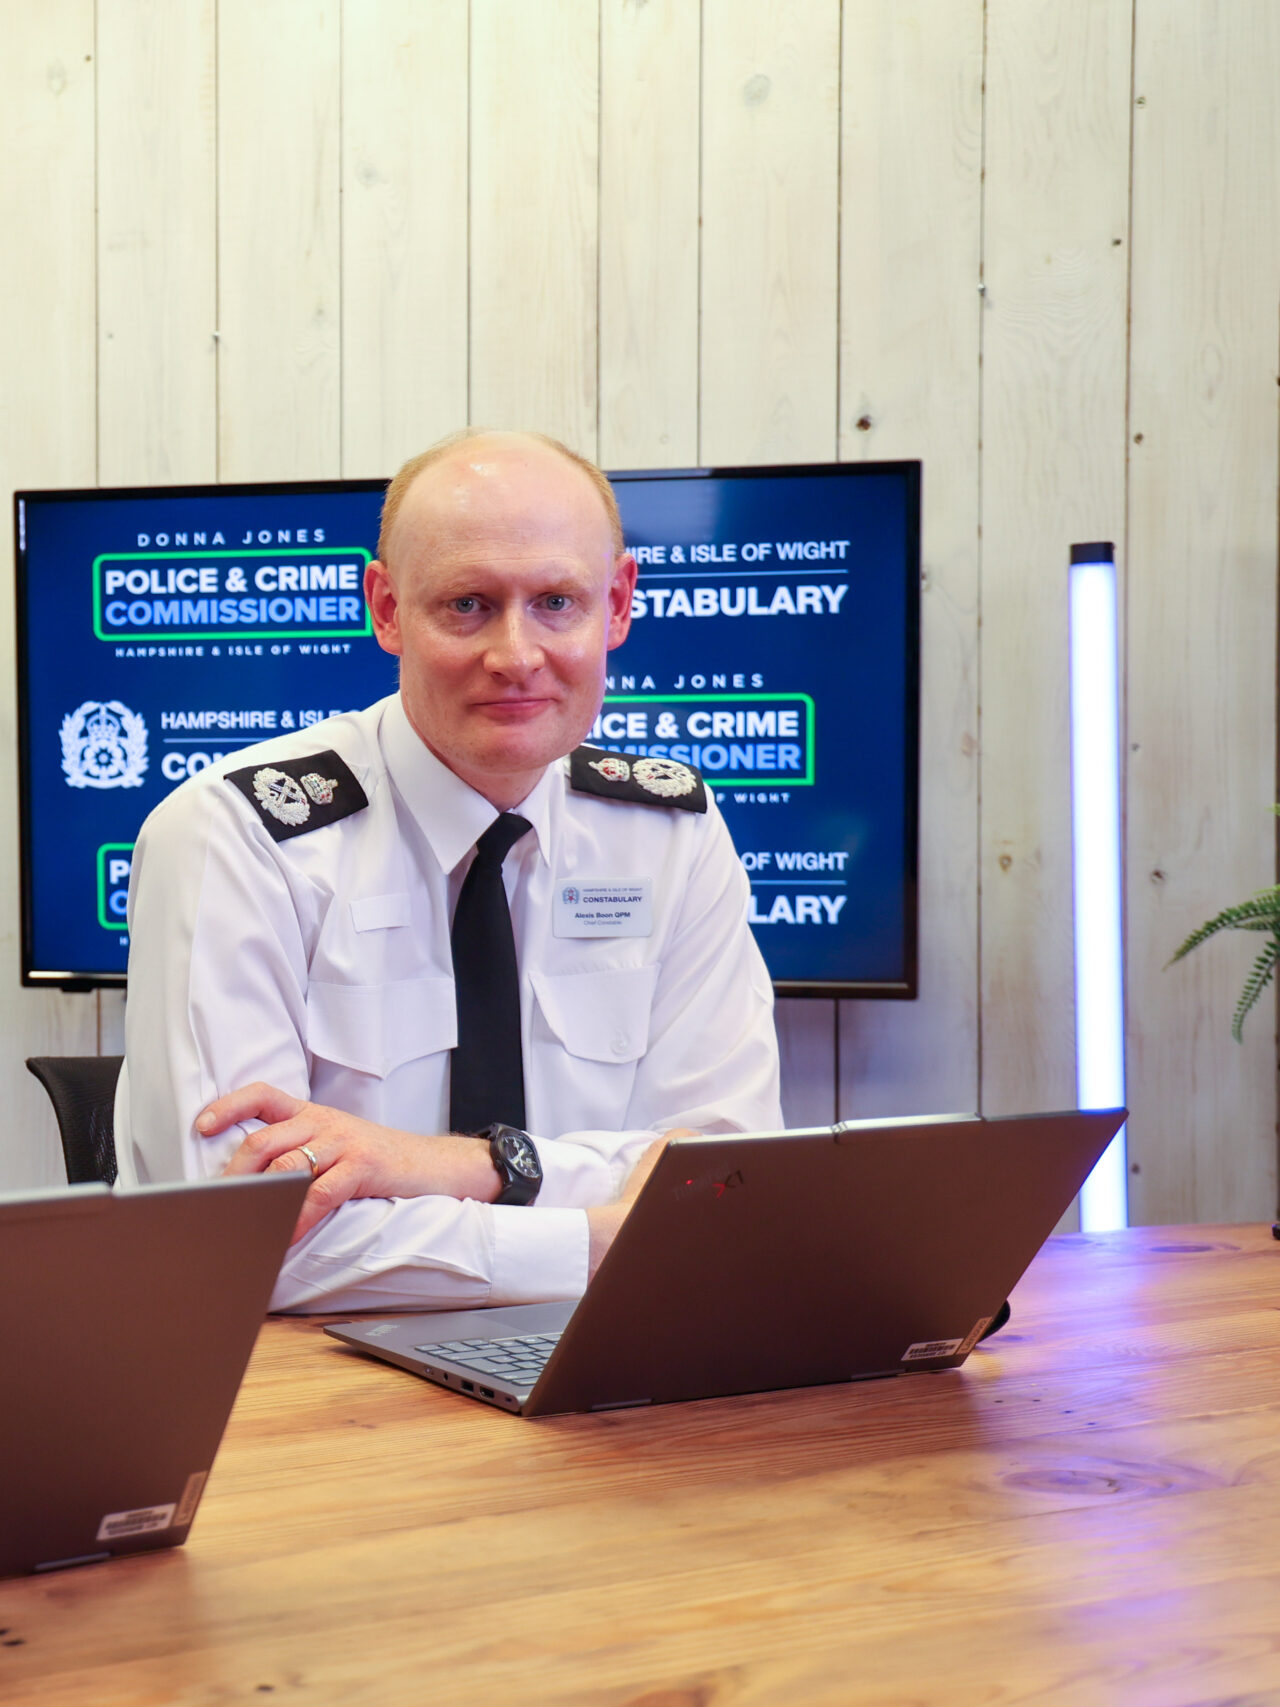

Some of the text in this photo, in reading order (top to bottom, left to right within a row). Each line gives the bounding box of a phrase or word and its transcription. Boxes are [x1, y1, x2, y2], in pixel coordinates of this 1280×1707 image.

[137, 529, 326, 547] DONNA JONES
[670, 545, 686, 564] &
[690, 544, 737, 563] ISLE
[741, 543, 772, 562] OF
[776, 540, 850, 560] WIGHT
[105, 564, 358, 596] POLICE & CRIME
[105, 596, 360, 626] COMMISSIONER
[115, 643, 351, 658] HAMPSHIRE & ISLE OF WIGHT
[674, 672, 764, 689] JONES
[161, 711, 277, 729] HAMPSHIRE
[280, 710, 295, 728] &
[586, 710, 799, 739] ICE & CRIME
[734, 792, 790, 804] WIGHT
[741, 852, 849, 871] OF WIGHT
